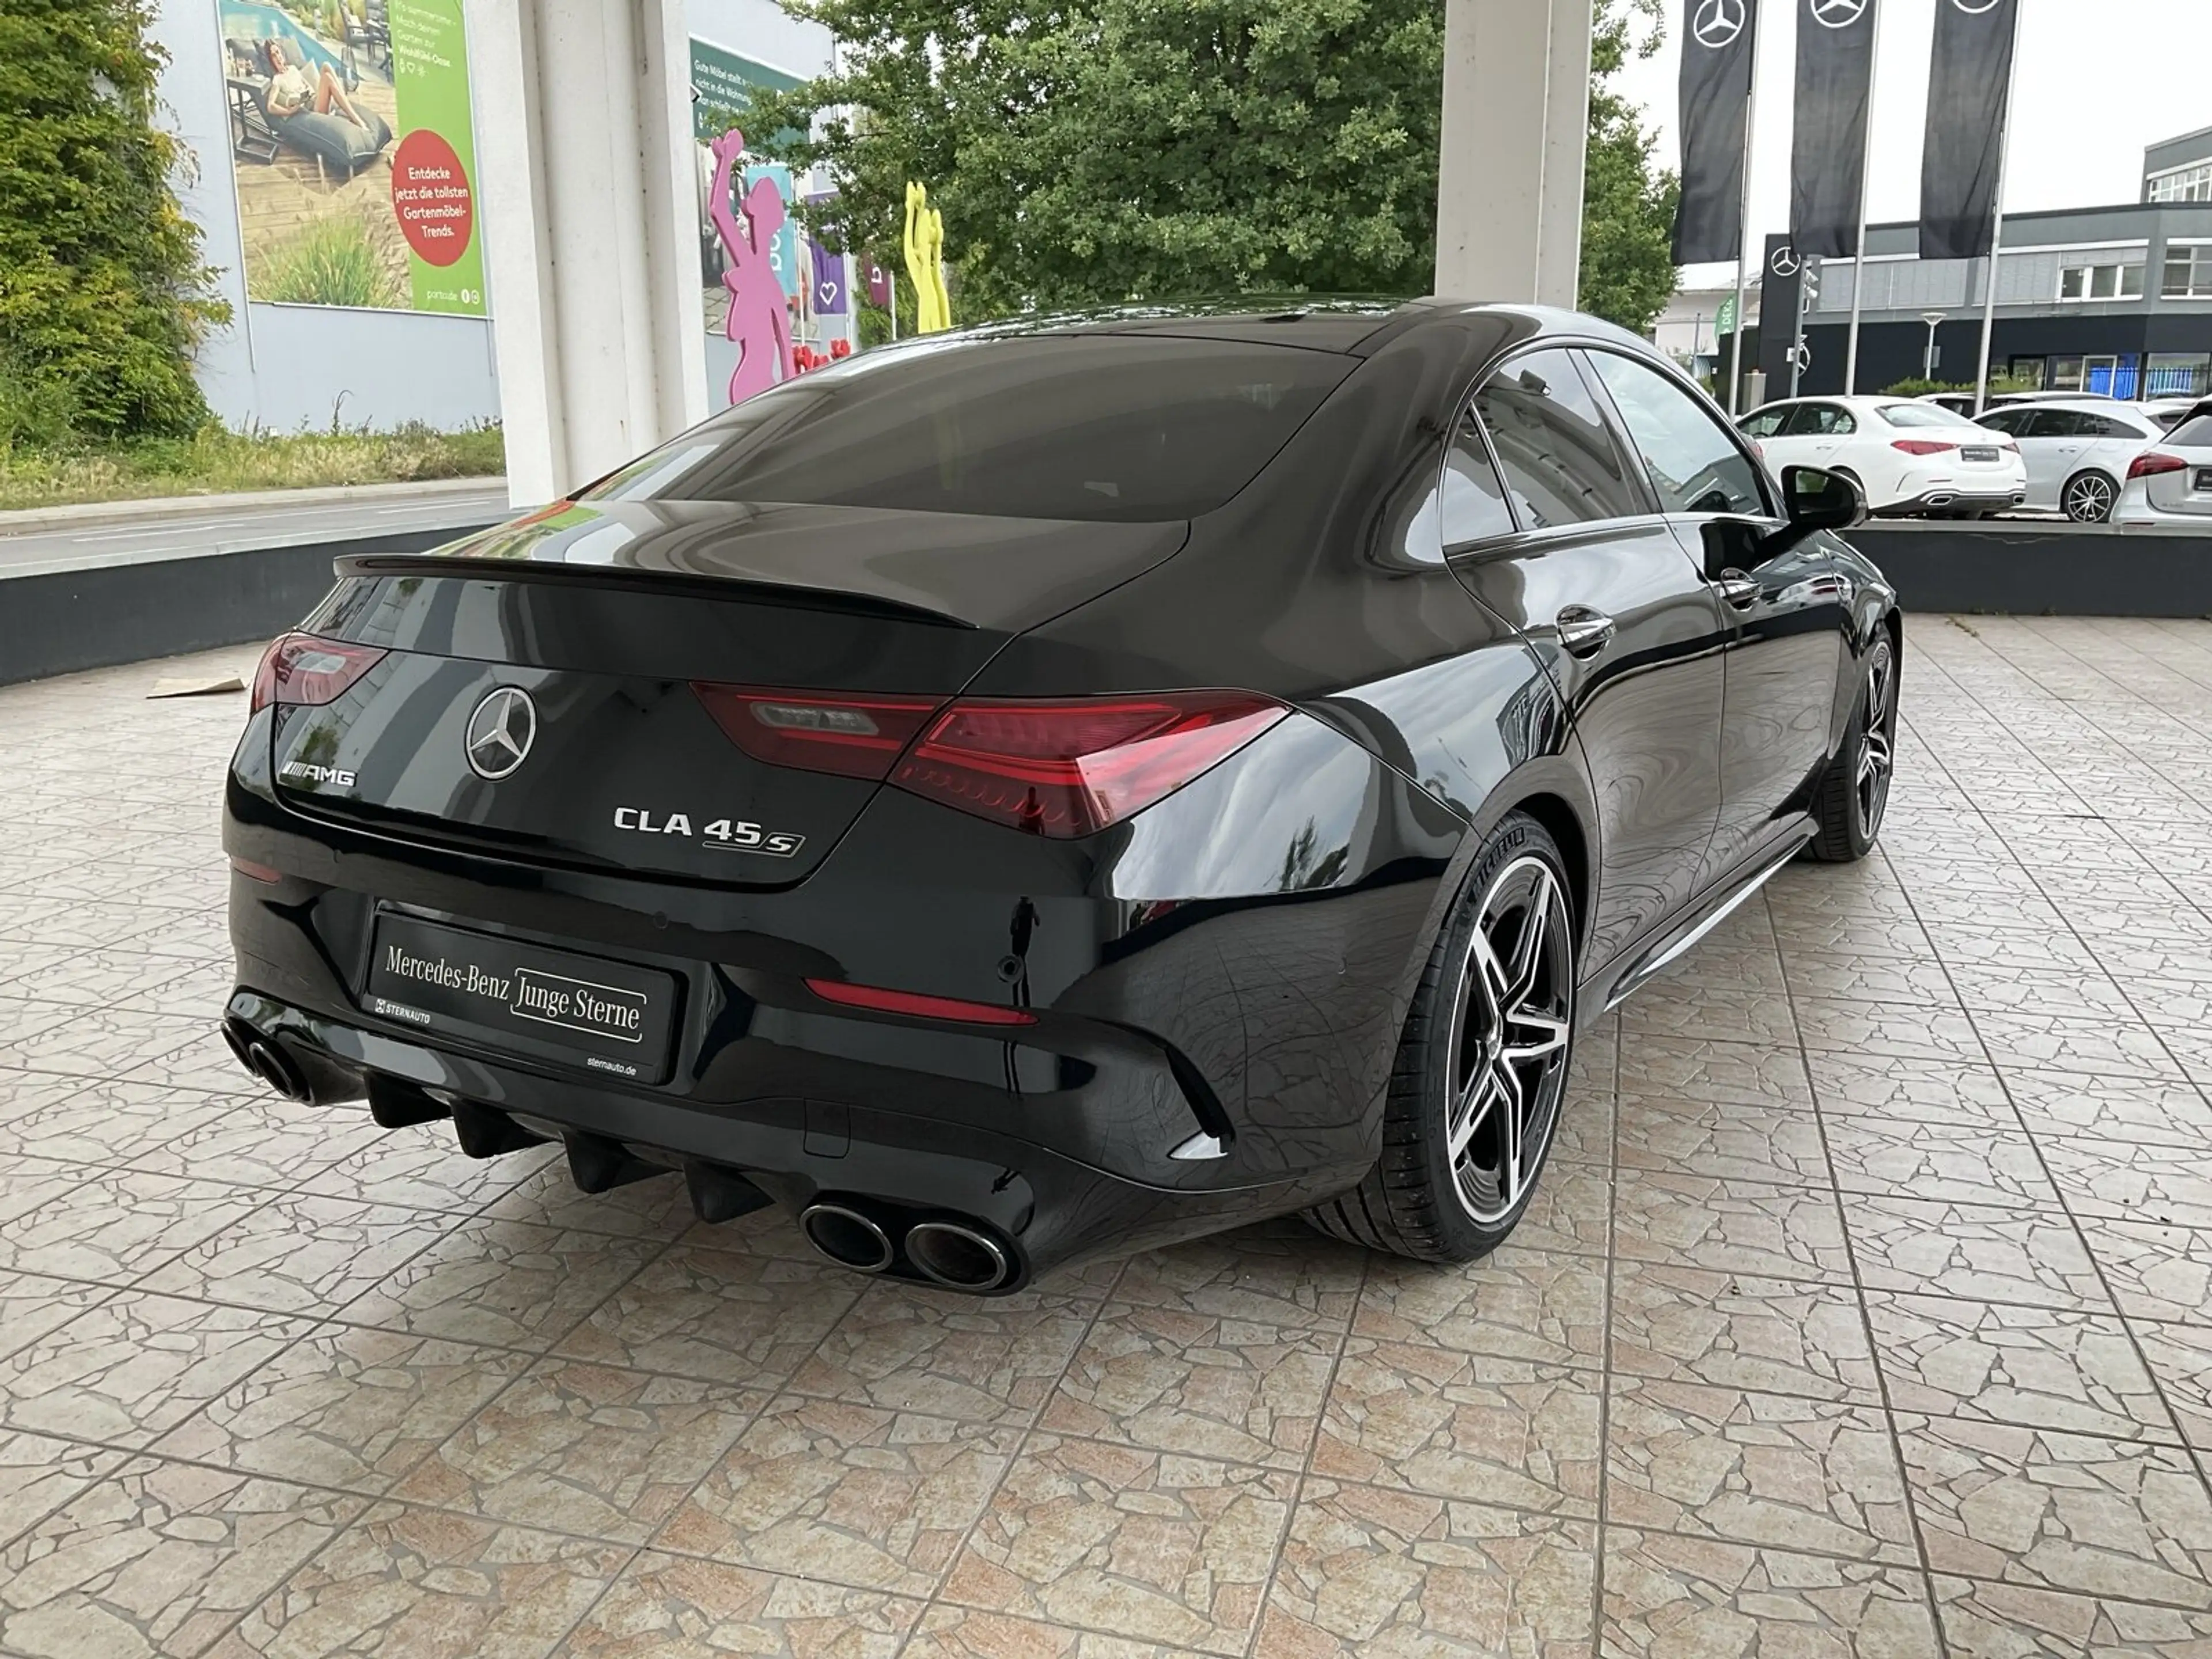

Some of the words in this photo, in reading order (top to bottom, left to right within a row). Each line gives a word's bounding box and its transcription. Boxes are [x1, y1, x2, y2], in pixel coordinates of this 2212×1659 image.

[396, 29, 423, 44] Garten
[694, 59, 709, 74] Gute
[709, 64, 727, 79] Möbel
[695, 77, 710, 90] nicht
[710, 82, 716, 92] in
[716, 84, 725, 94] die
[408, 166, 451, 180] Entdecke
[394, 187, 418, 203] jetzt
[419, 185, 434, 199] die
[434, 185, 468, 198] tollsten
[403, 204, 467, 219] Gartenmöbel-
[421, 224, 454, 237] Trends.
[302, 764, 356, 786] AMG
[613, 807, 692, 836] CLA
[385, 945, 510, 1001] Mercedes-Benz
[515, 976, 570, 1018] Junge
[573, 988, 639, 1029] Sterne
[385, 1003, 431, 1024] STERNAUTO
[586, 1057, 637, 1076] sternauto.de
